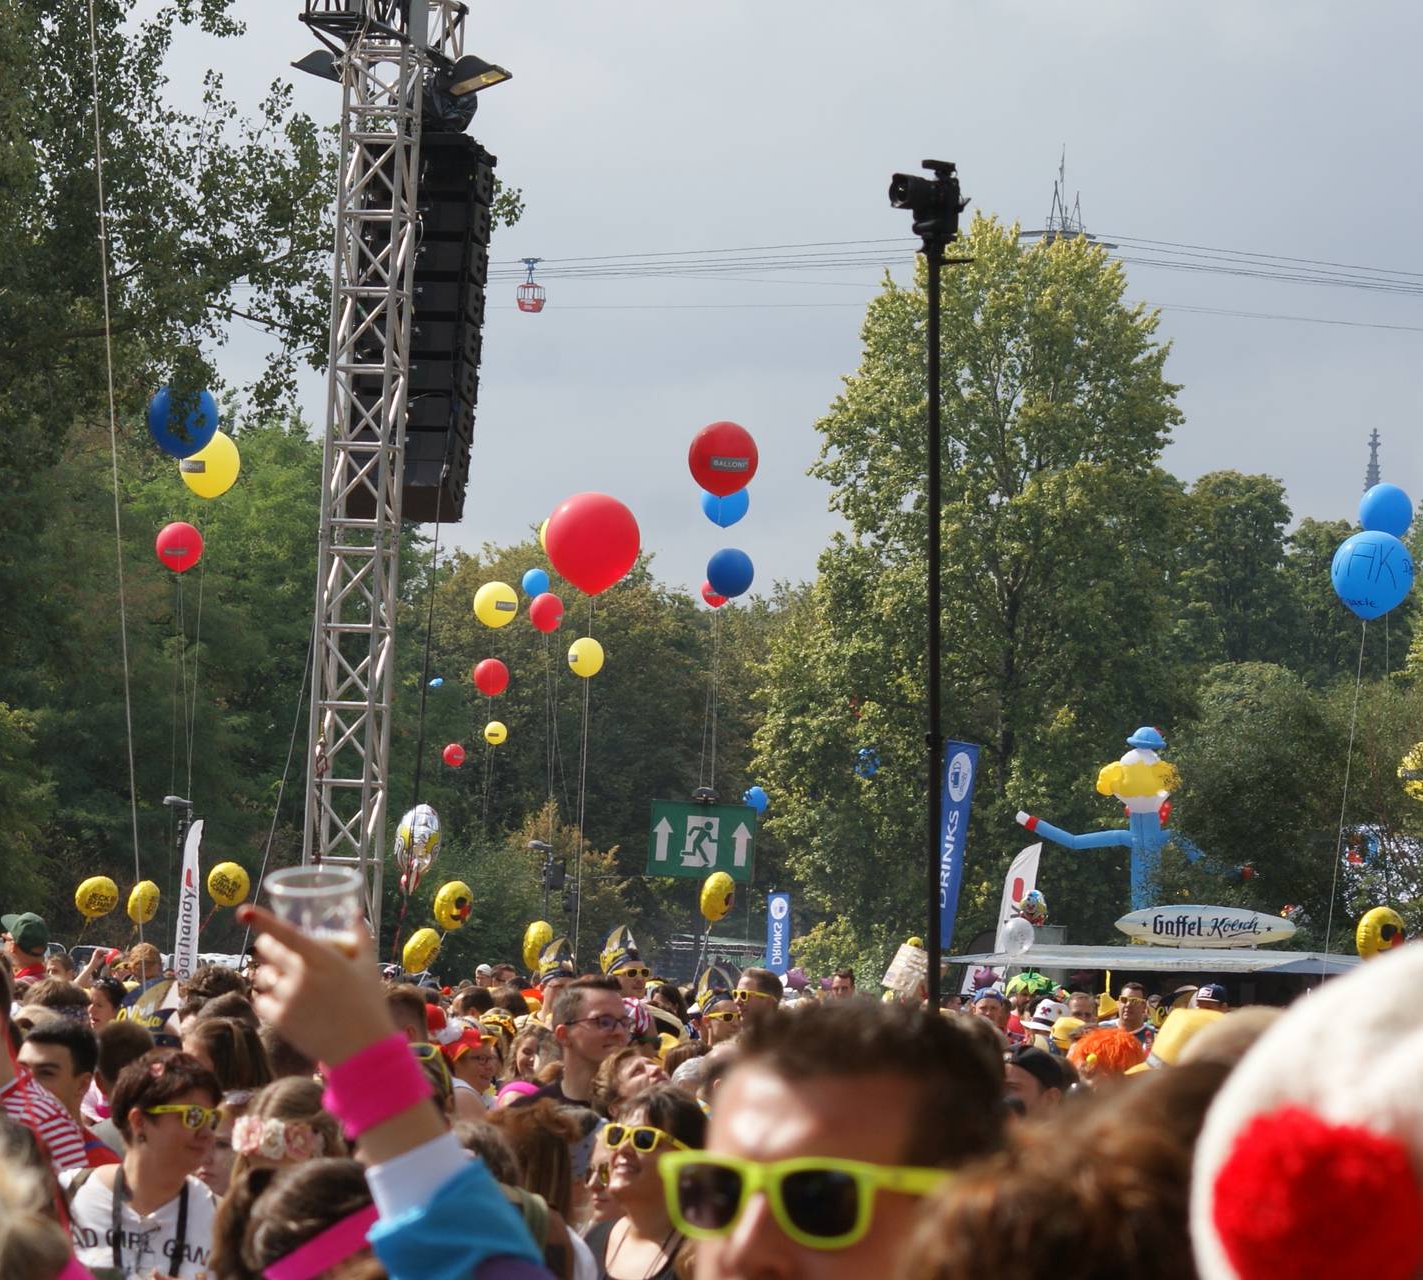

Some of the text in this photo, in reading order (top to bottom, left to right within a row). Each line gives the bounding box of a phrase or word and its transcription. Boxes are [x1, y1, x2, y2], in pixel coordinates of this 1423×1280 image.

[1152, 914, 1203, 938] Gaffel
[71, 1227, 98, 1249] AD
[163, 1238, 210, 1266] GAN
